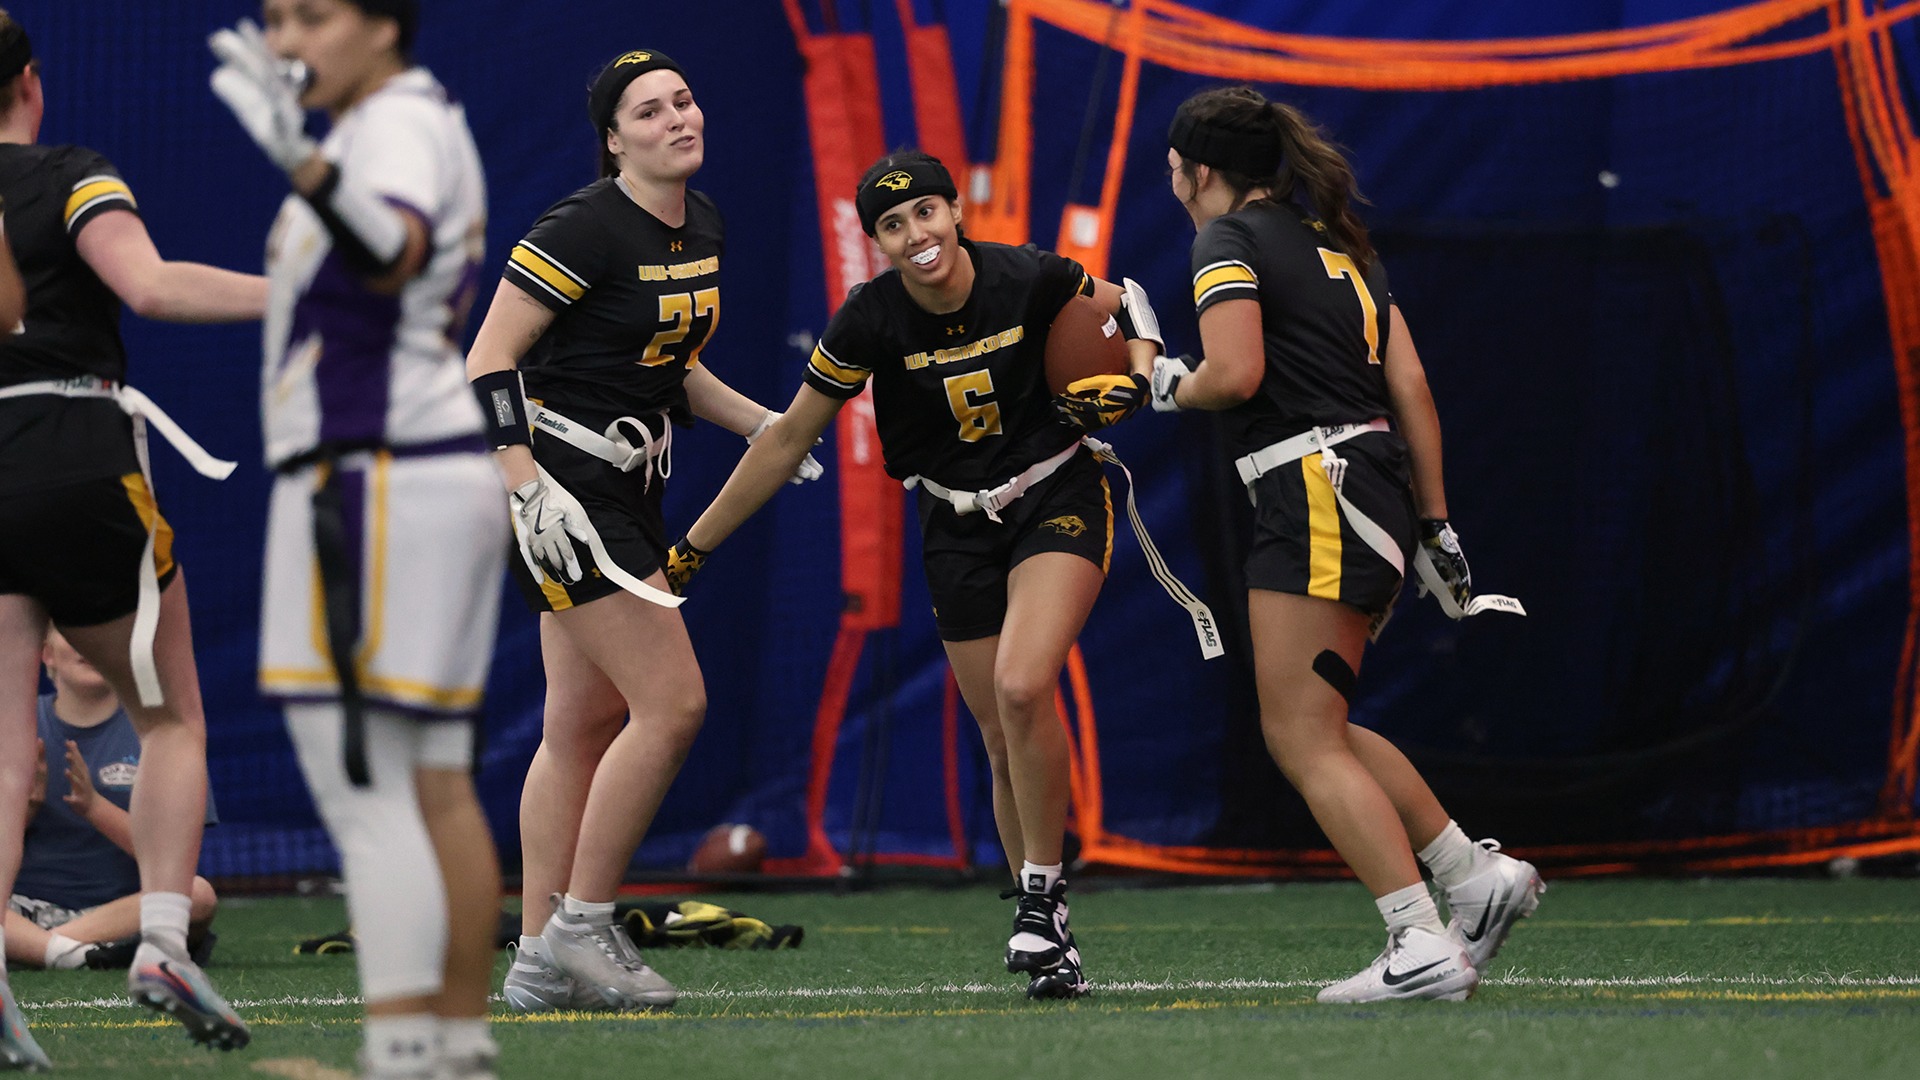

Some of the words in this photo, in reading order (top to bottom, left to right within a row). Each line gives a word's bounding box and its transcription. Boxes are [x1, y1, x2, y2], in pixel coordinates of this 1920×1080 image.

[635, 286, 720, 370] 27
[1317, 247, 1381, 365] 7
[535, 412, 569, 434] Franklin
[943, 368, 1003, 443] 6
